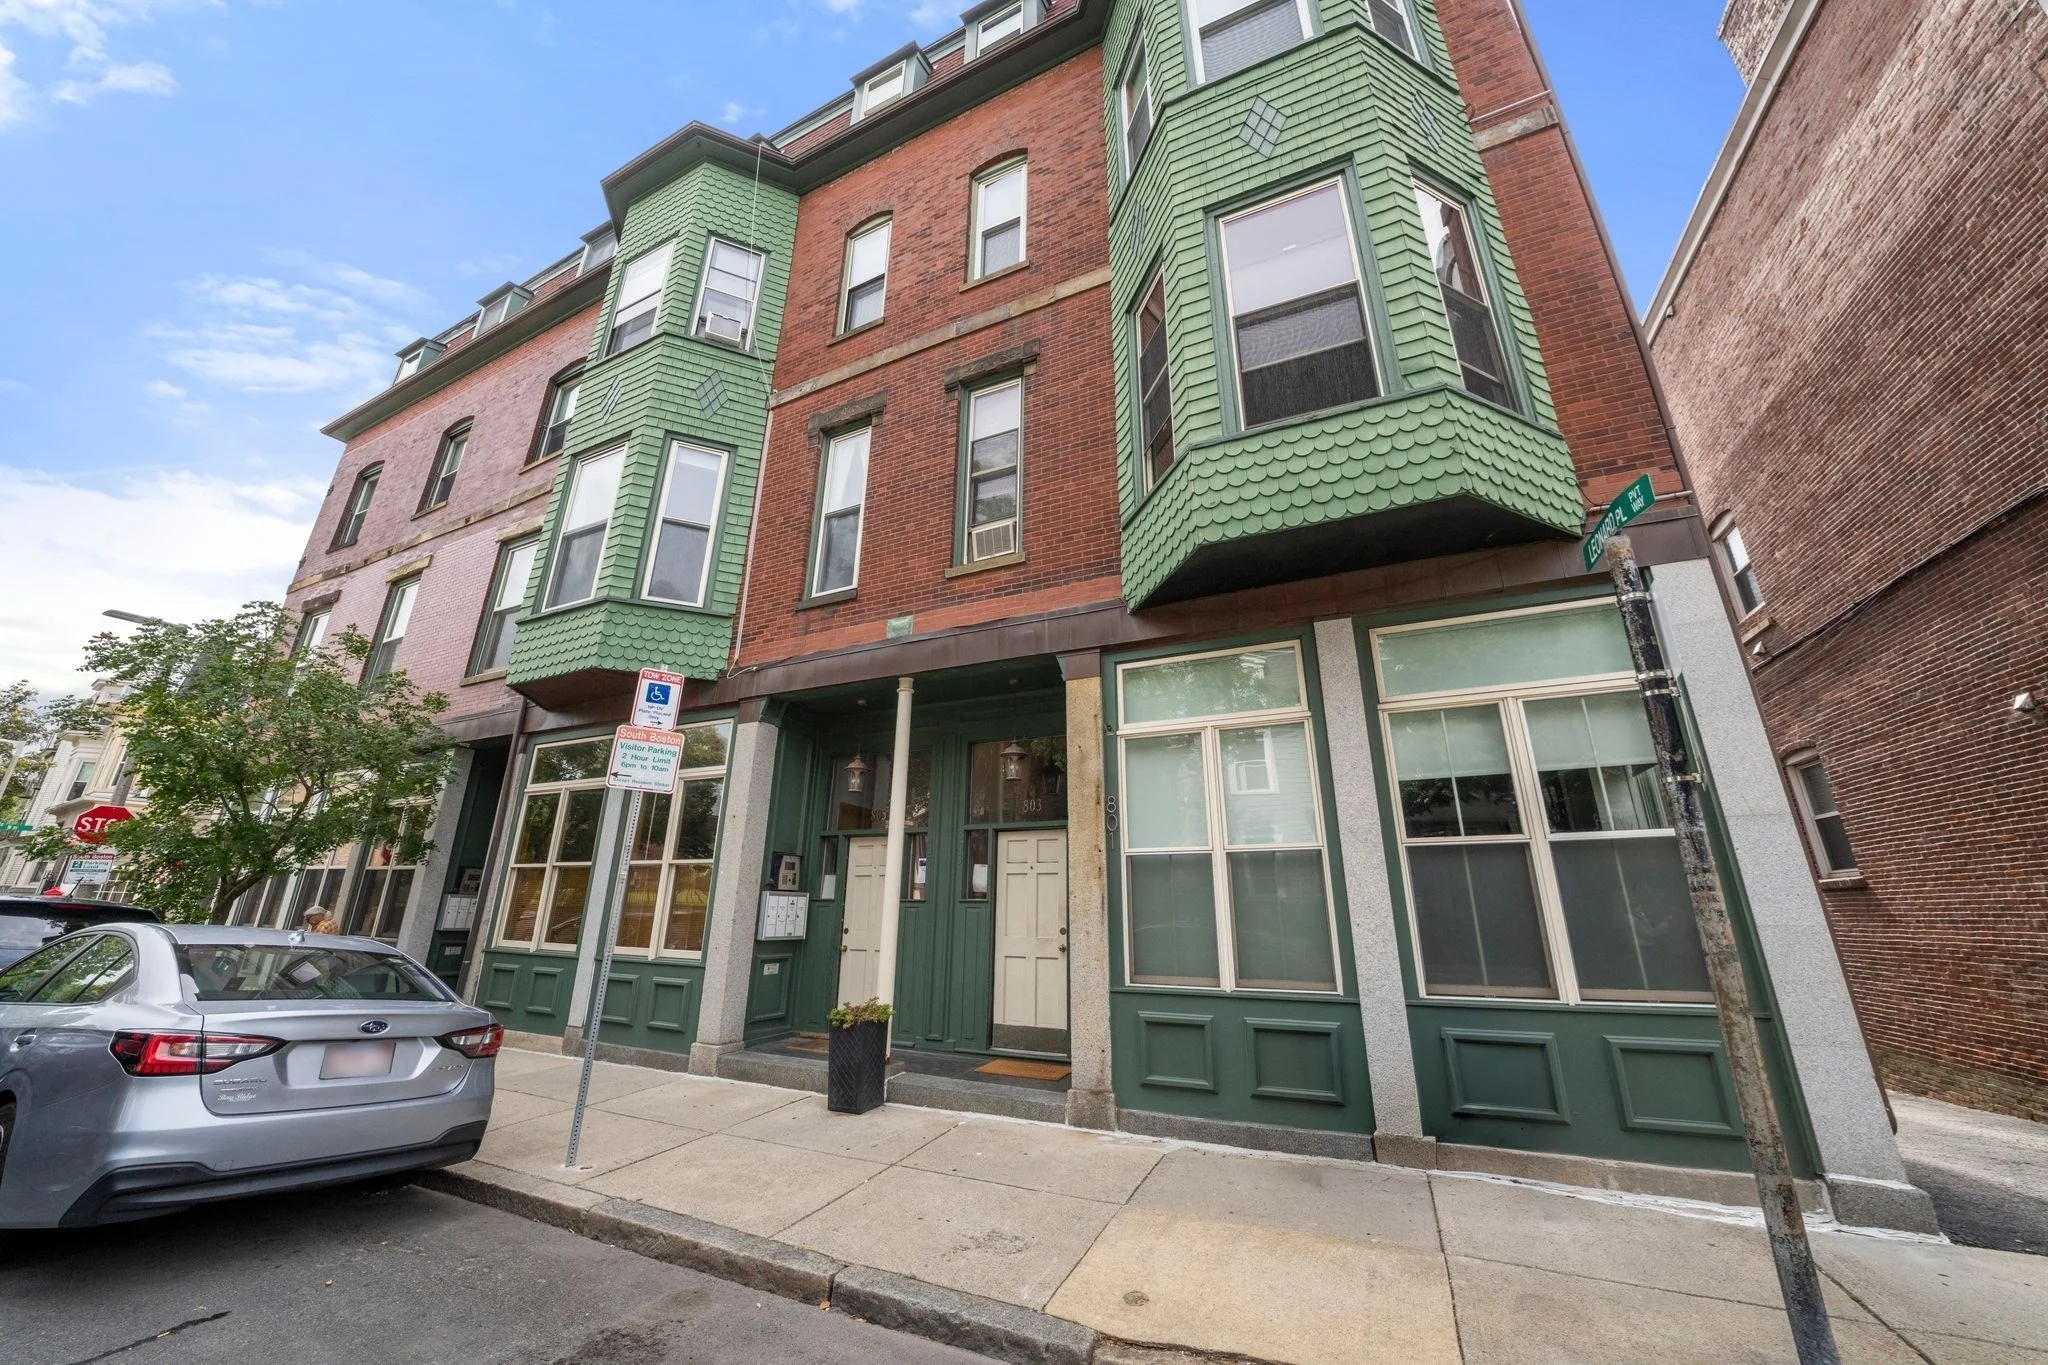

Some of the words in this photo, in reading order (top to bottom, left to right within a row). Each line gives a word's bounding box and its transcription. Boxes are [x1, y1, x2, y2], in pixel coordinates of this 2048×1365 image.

[1628, 485, 1640, 502] PVT
[1631, 495, 1645, 513] WAY
[1588, 512, 1616, 563] LEONARD
[1614, 506, 1628, 526] PL
[643, 670, 660, 680] TOW
[661, 672, 682, 683] ZONE
[619, 729, 647, 740] South
[650, 733, 681, 745] Boston
[620, 742, 646, 752] Visitor
[647, 745, 677, 757] Parking
[621, 761, 637, 769] 6pm
[631, 753, 649, 763] Hour
[652, 756, 671, 765] Limit
[1023, 799, 1042, 813] 803
[1106, 795, 1118, 850] 801
[212, 1078, 267, 1086] SUBARU
